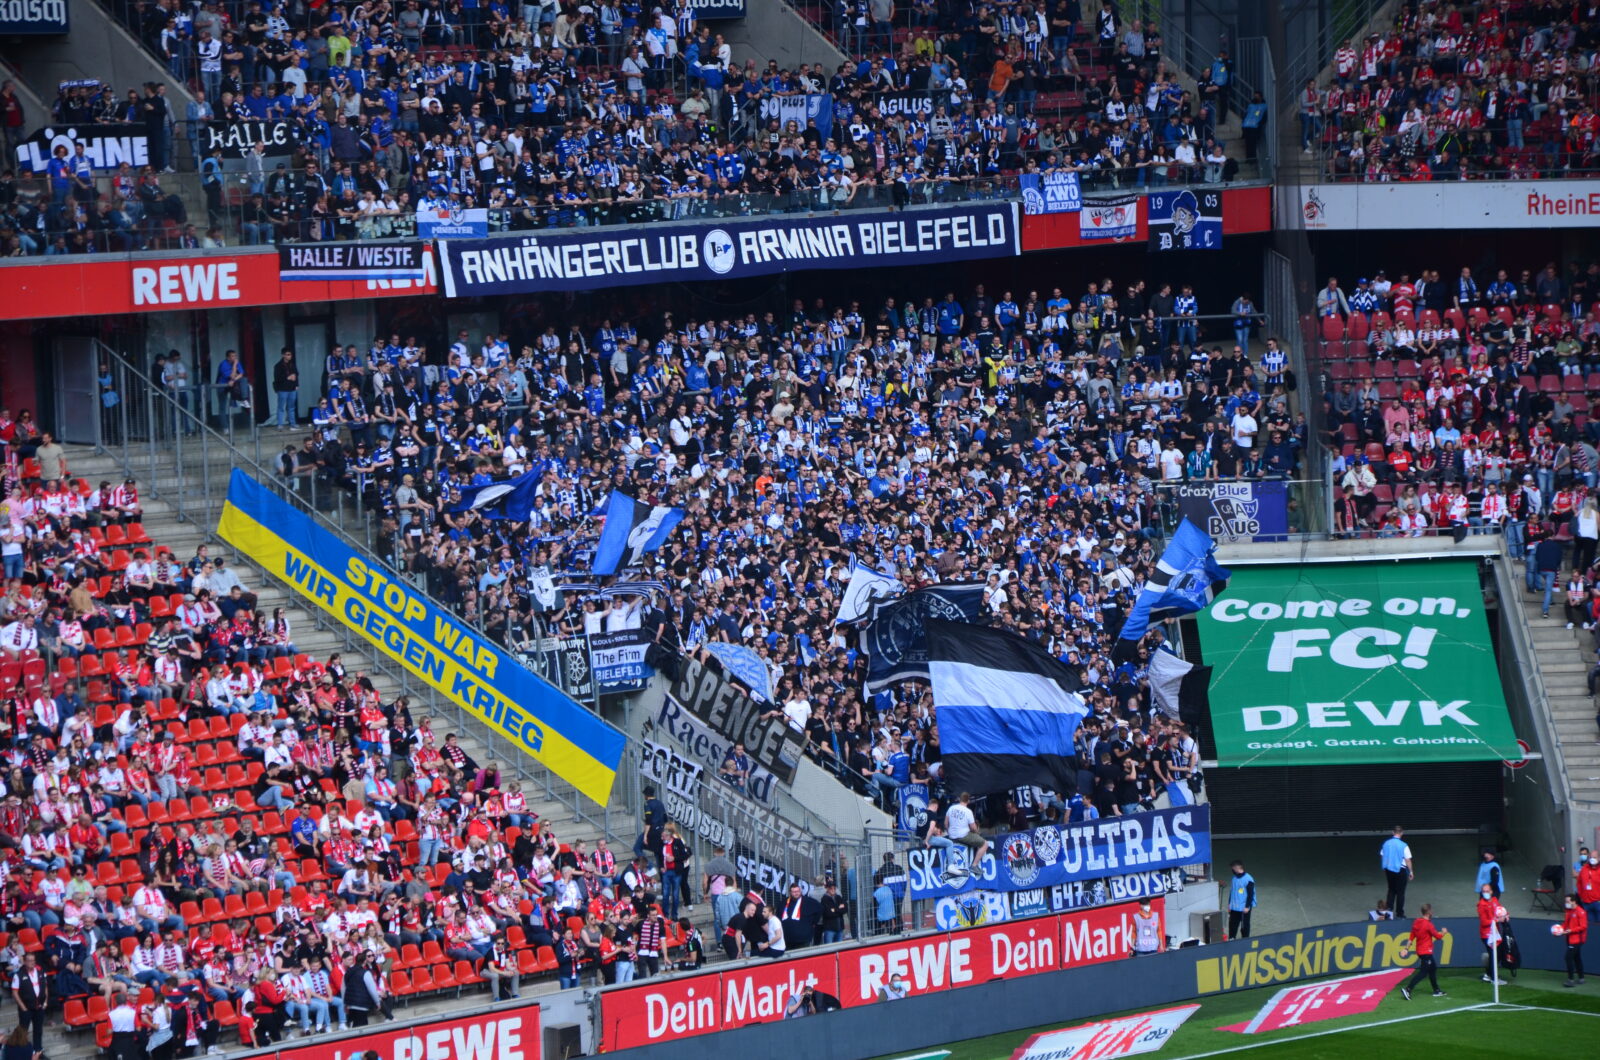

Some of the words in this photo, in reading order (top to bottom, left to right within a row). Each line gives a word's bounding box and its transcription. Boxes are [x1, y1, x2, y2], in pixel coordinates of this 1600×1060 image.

[28, 127, 149, 172] LÖHNE
[208, 123, 287, 149] HALLE
[1045, 185, 1079, 202] ZWO
[1047, 201, 1081, 211] BIELEFELD
[1151, 196, 1164, 210] 19
[1205, 194, 1218, 208] 05
[289, 247, 344, 268] HALLE
[346, 246, 355, 267] /
[357, 246, 415, 267] WESTF.
[462, 237, 699, 284] ANHÄNGERCLUB
[738, 222, 855, 266] ARMINIA
[859, 212, 1007, 255] BIELEFELD
[132, 262, 241, 306] REWE
[1180, 485, 1215, 500] Crazy
[1217, 484, 1249, 496] Blue
[344, 556, 428, 625] STOP
[434, 621, 499, 681] WAR
[1210, 598, 1373, 624] Come
[1383, 596, 1472, 619] on,
[284, 551, 339, 605] WIR
[343, 597, 446, 683] GEGEN
[452, 670, 545, 754] KRIEG
[594, 652, 615, 665] The
[617, 648, 641, 662] Firm
[1266, 625, 1439, 673] FC!
[594, 665, 643, 680] BIELEFELD
[679, 658, 787, 767] SPENGE
[1241, 700, 1481, 732] DEVK
[1246, 739, 1318, 751] Gesagt.
[1324, 738, 1387, 748] Getan.
[1393, 736, 1487, 747] Geholfen.
[1017, 790, 1032, 808] 19
[1061, 812, 1196, 874] ULTRAS
[1051, 881, 1083, 909] 647
[1112, 870, 1164, 899] BOYS
[859, 938, 973, 1000] REWE
[991, 928, 1054, 975] Dein
[1220, 924, 1454, 991] wisskirchen
[646, 989, 714, 1038] Dein
[724, 969, 819, 1022] Markt
